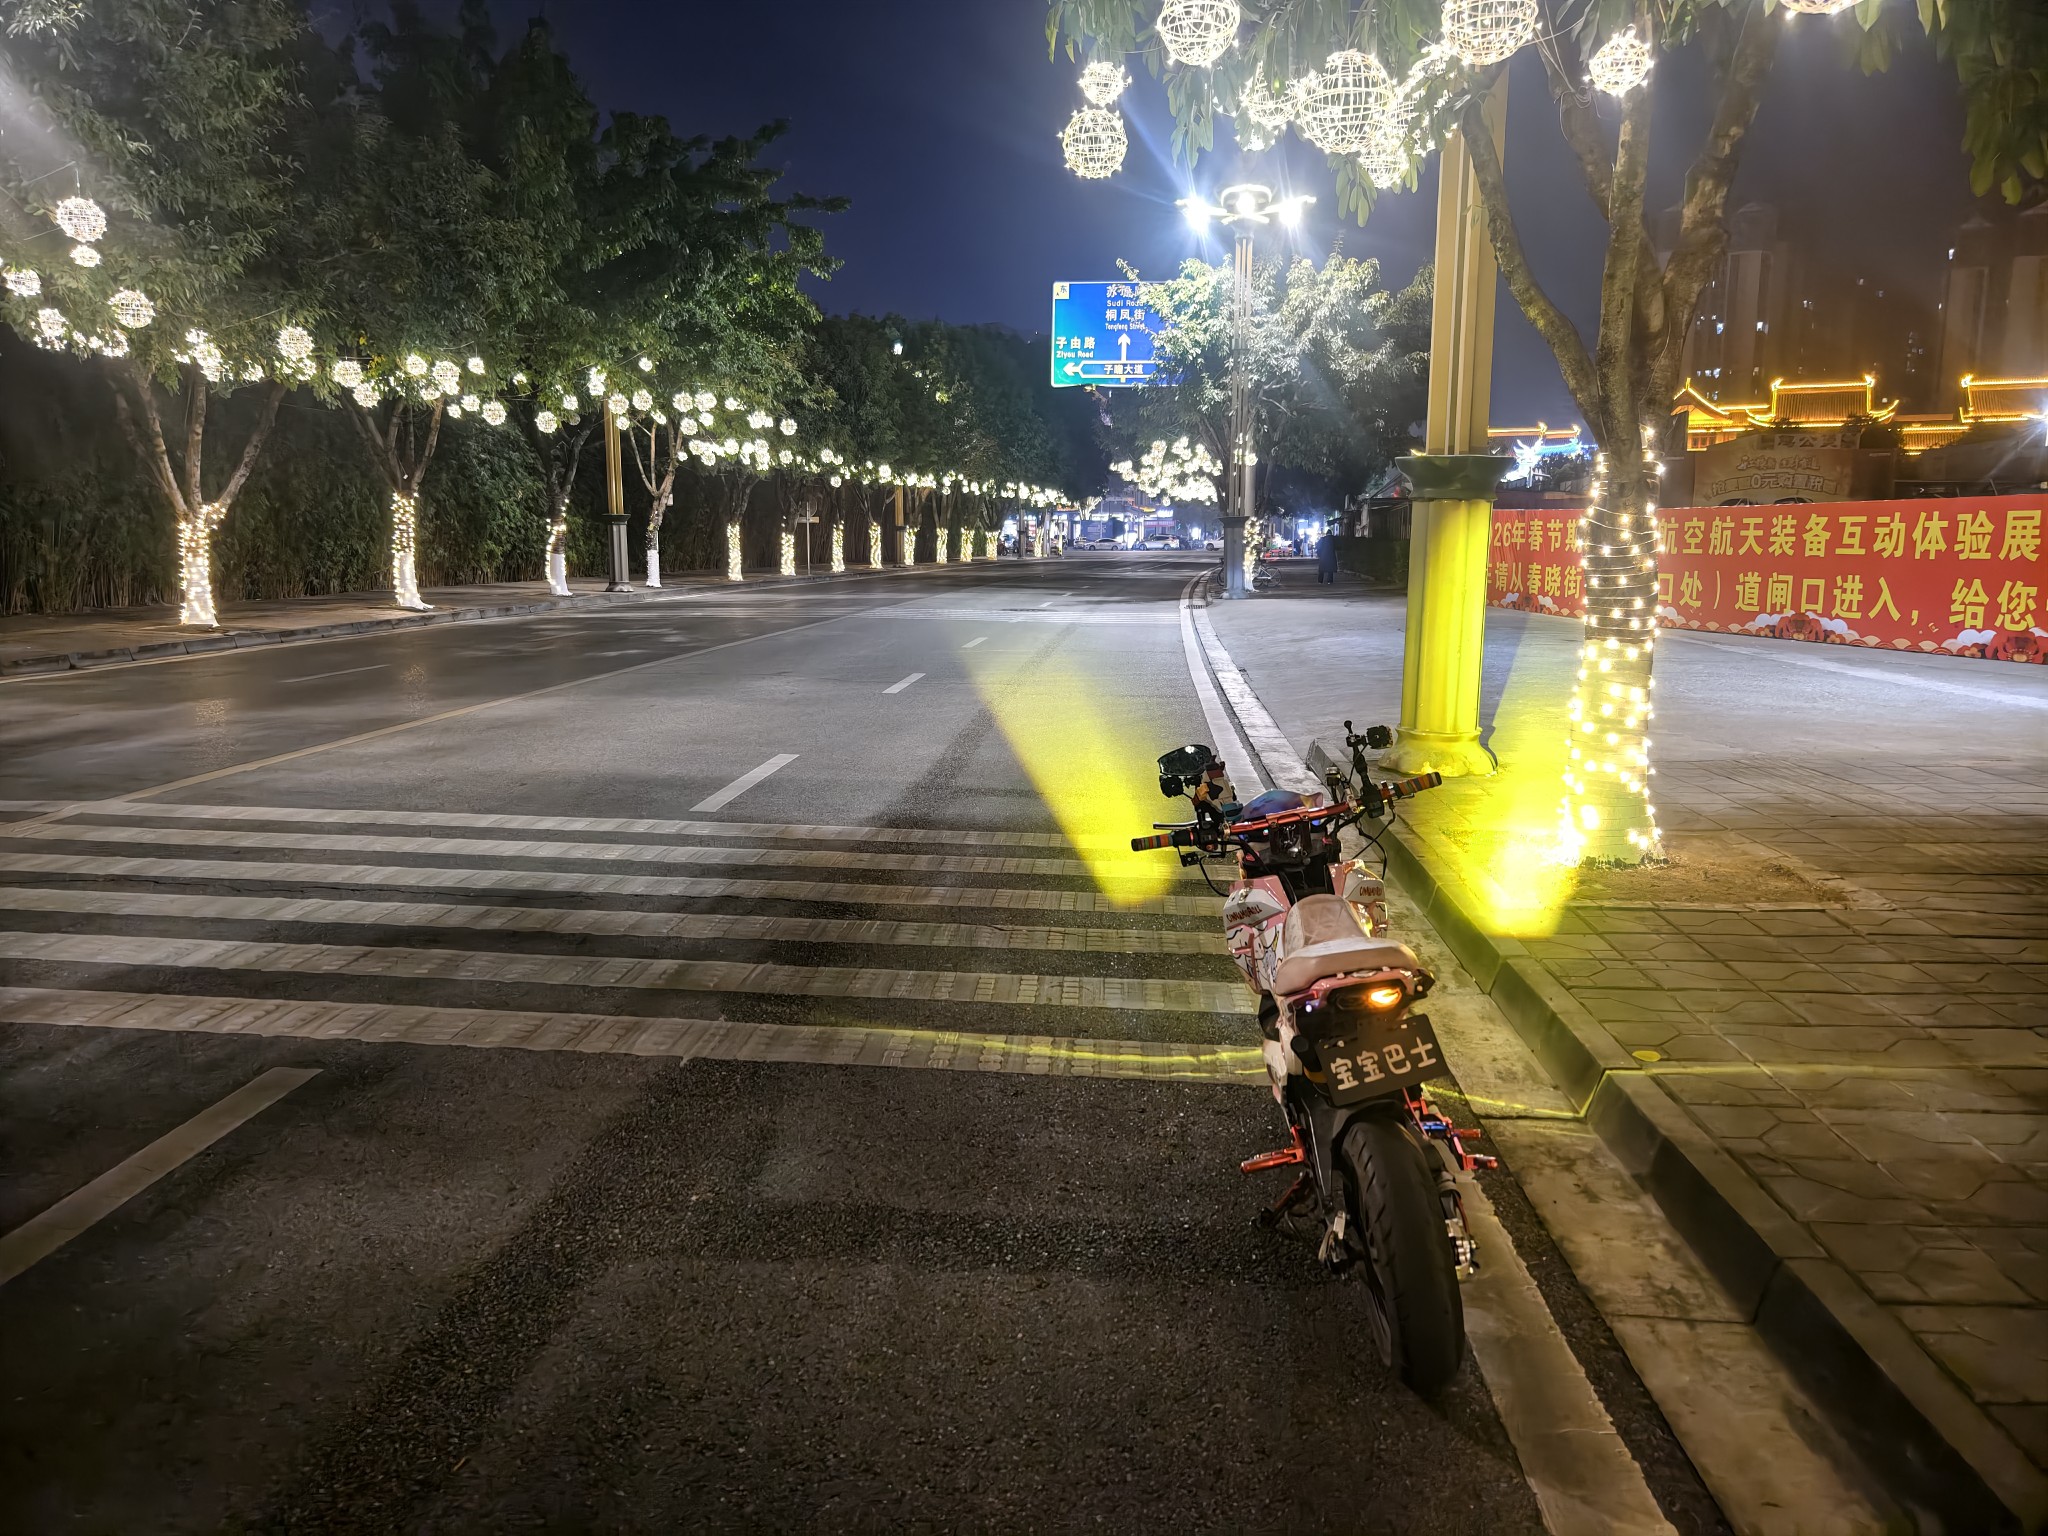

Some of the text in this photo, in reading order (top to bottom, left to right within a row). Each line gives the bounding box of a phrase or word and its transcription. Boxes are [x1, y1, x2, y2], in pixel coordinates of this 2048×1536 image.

[1060, 285, 1067, 294] 东
[1106, 284, 1141, 298] 苏堤
[1105, 308, 1145, 322] 桐凤街
[1056, 336, 1096, 349] 子由路
[1056, 351, 1076, 359] Ziyou
[1490, 518, 1583, 553] 26年春节期
[1330, 1036, 1437, 1090] 宝宝巴士
